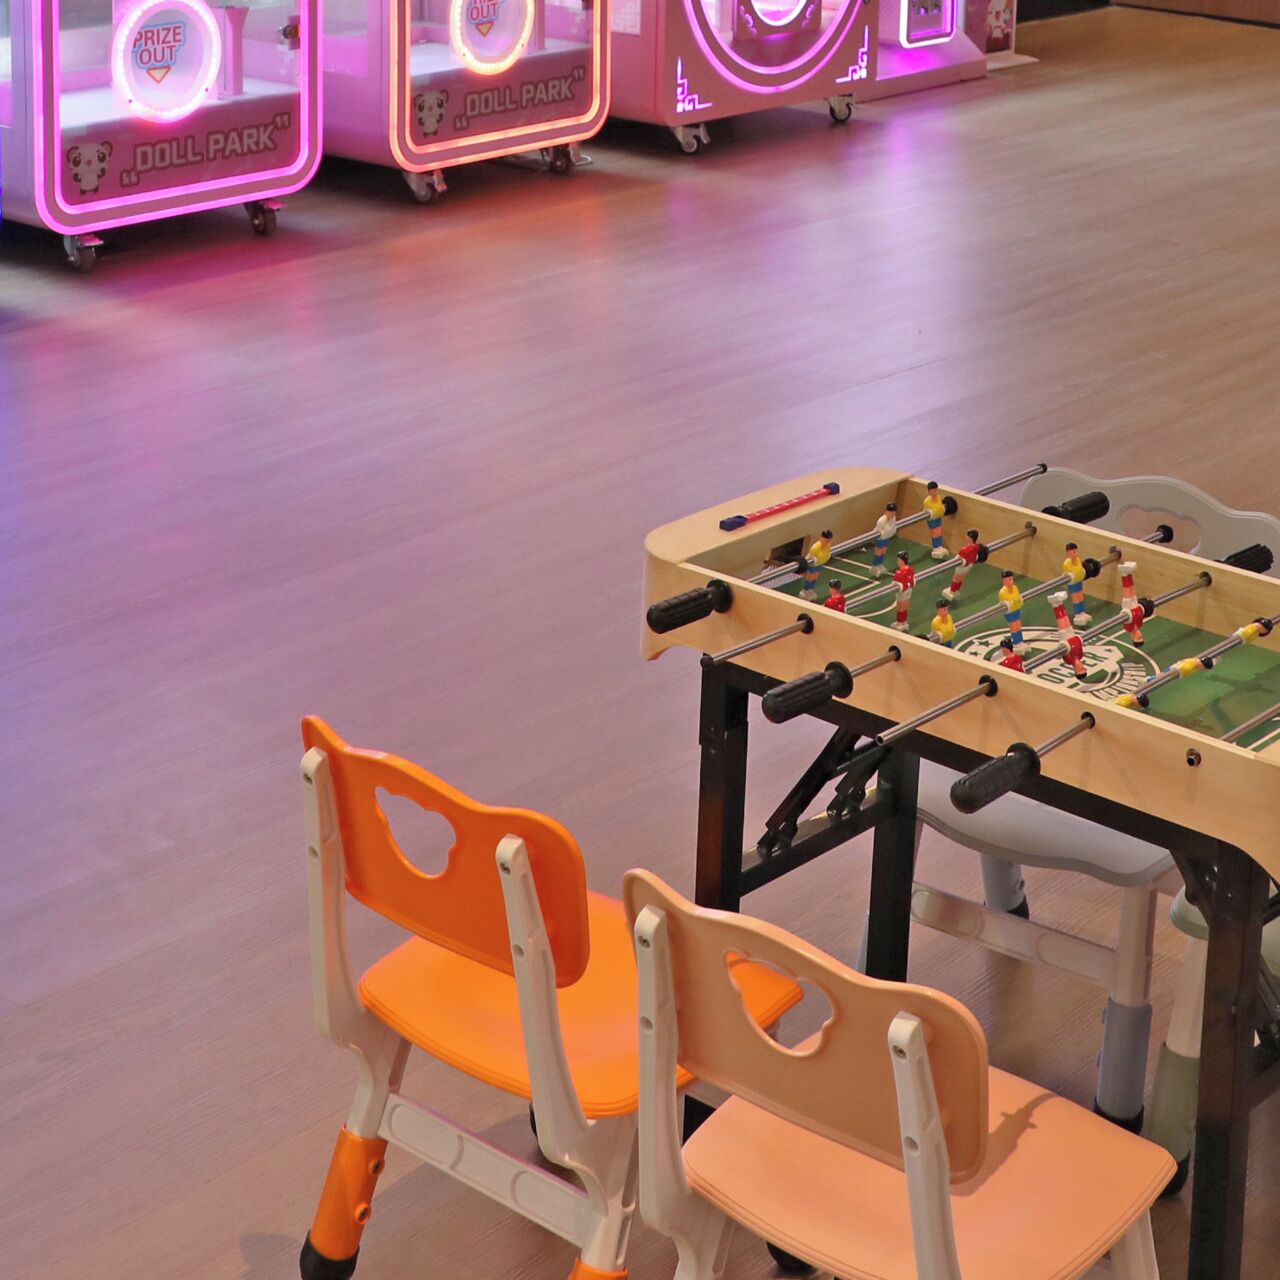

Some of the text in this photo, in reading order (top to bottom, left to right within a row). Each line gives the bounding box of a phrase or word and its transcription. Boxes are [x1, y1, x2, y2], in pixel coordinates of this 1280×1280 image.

[470, 2, 498, 21] OUT
[133, 25, 183, 49] PRIZE
[139, 44, 177, 66] OUT
